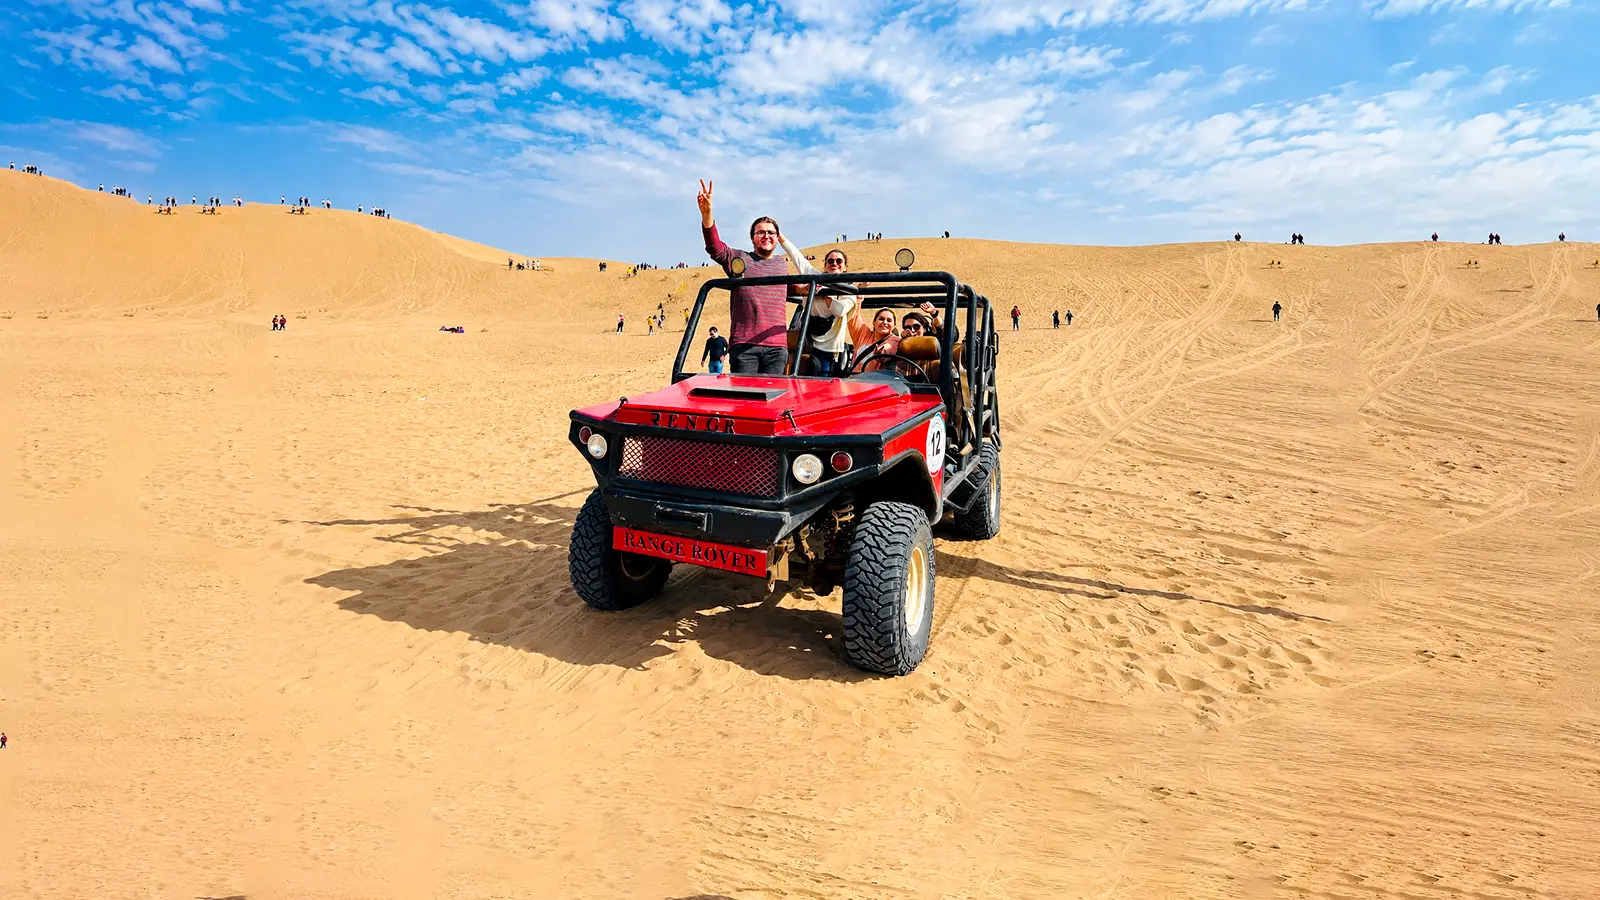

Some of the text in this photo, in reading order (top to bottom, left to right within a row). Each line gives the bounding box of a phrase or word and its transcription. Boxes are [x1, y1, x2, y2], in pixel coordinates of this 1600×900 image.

[931, 430, 940, 457] 12
[624, 532, 757, 570] RANGE ROVER
